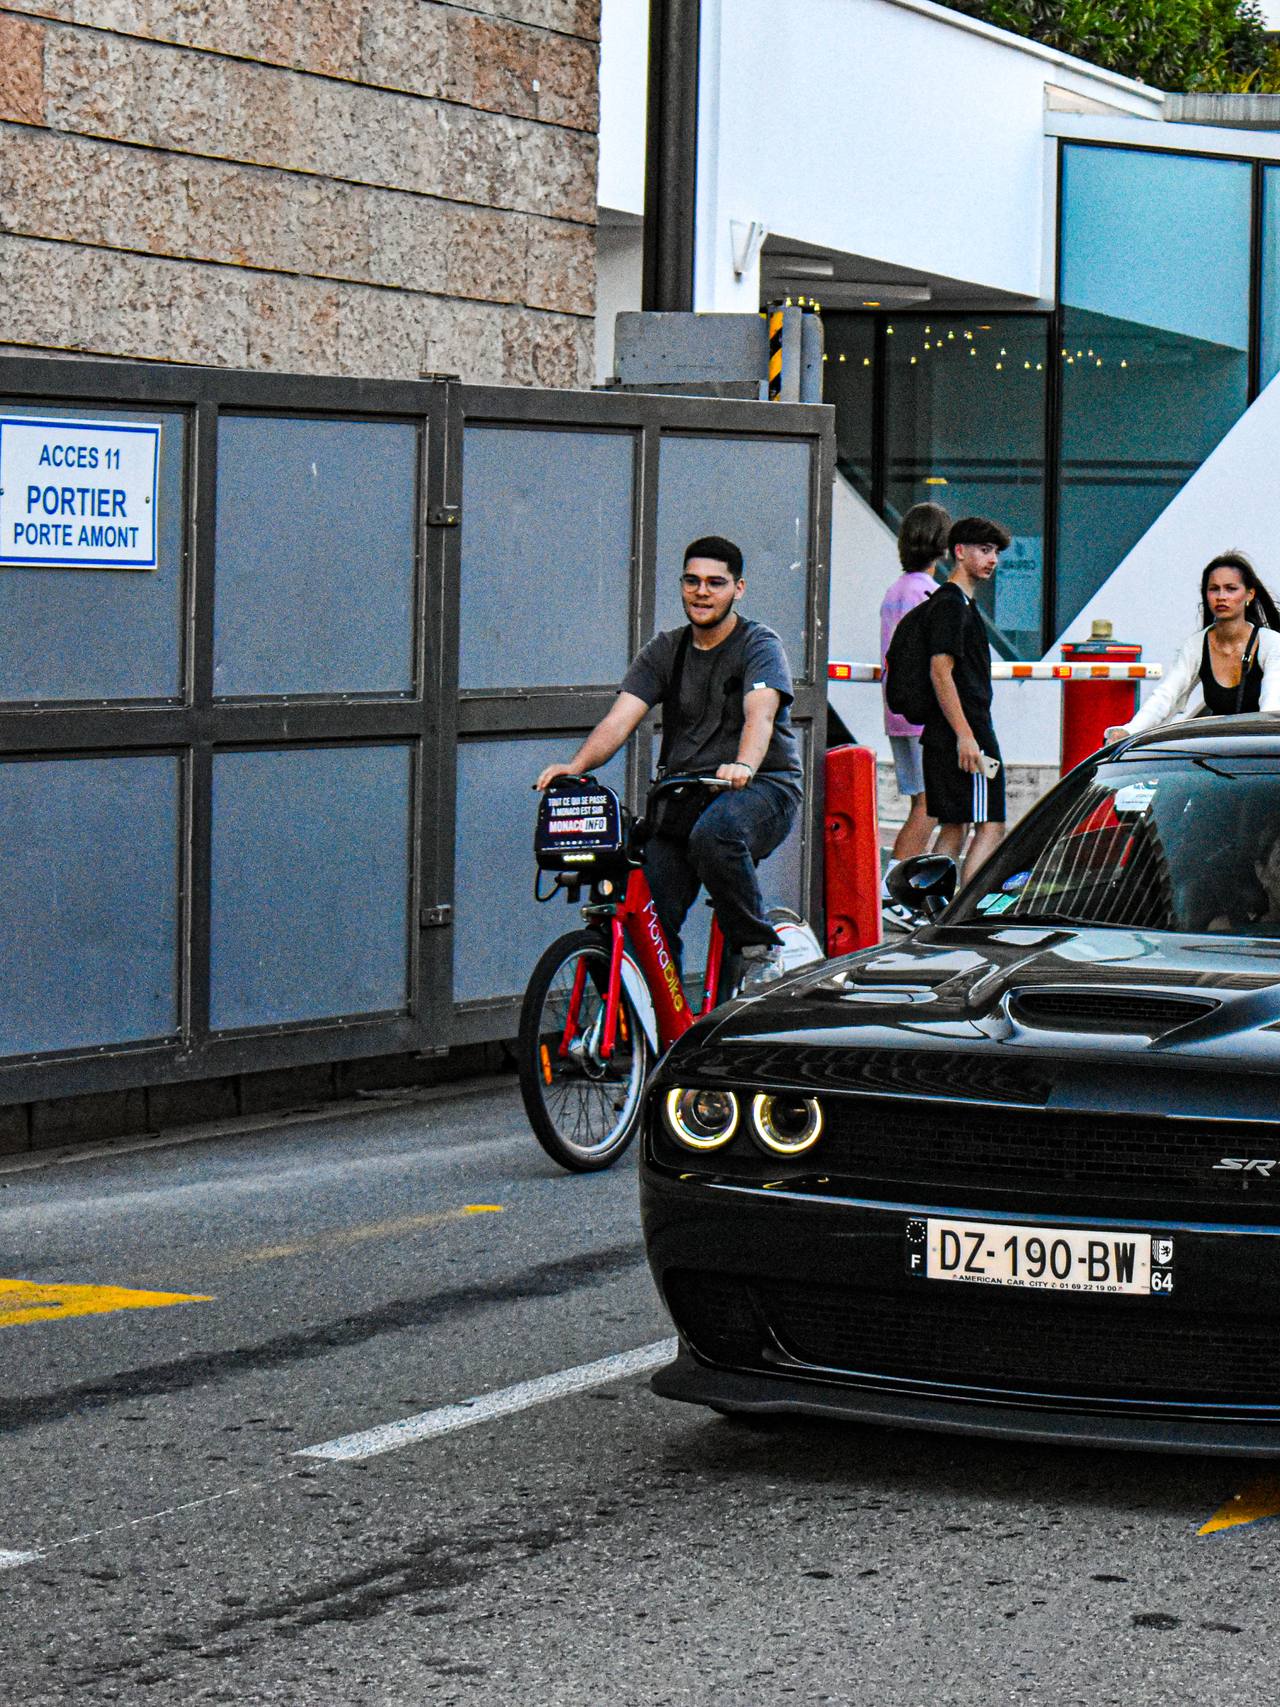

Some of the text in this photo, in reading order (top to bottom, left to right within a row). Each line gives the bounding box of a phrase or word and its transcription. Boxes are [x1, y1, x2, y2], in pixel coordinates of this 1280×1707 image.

[39, 444, 121, 470] ACCES 11
[27, 485, 127, 518] PORTIER
[14, 522, 139, 548] PORTE AMONT
[548, 798, 562, 806] TOUT
[563, 797, 570, 806] CE
[582, 796, 589, 805] SE
[589, 795, 607, 804] PASSE
[557, 807, 580, 816] MONACO
[581, 806, 592, 815] EST
[592, 806, 603, 814] SUR
[549, 819, 605, 832] MONACO INFO
[911, 1254, 921, 1269] F
[940, 1229, 1136, 1284] DZ-190-BW
[959, 1274, 1003, 1284] AMERICAN
[1007, 1278, 1025, 1286] CAR
[1151, 1271, 1174, 1292] 64
